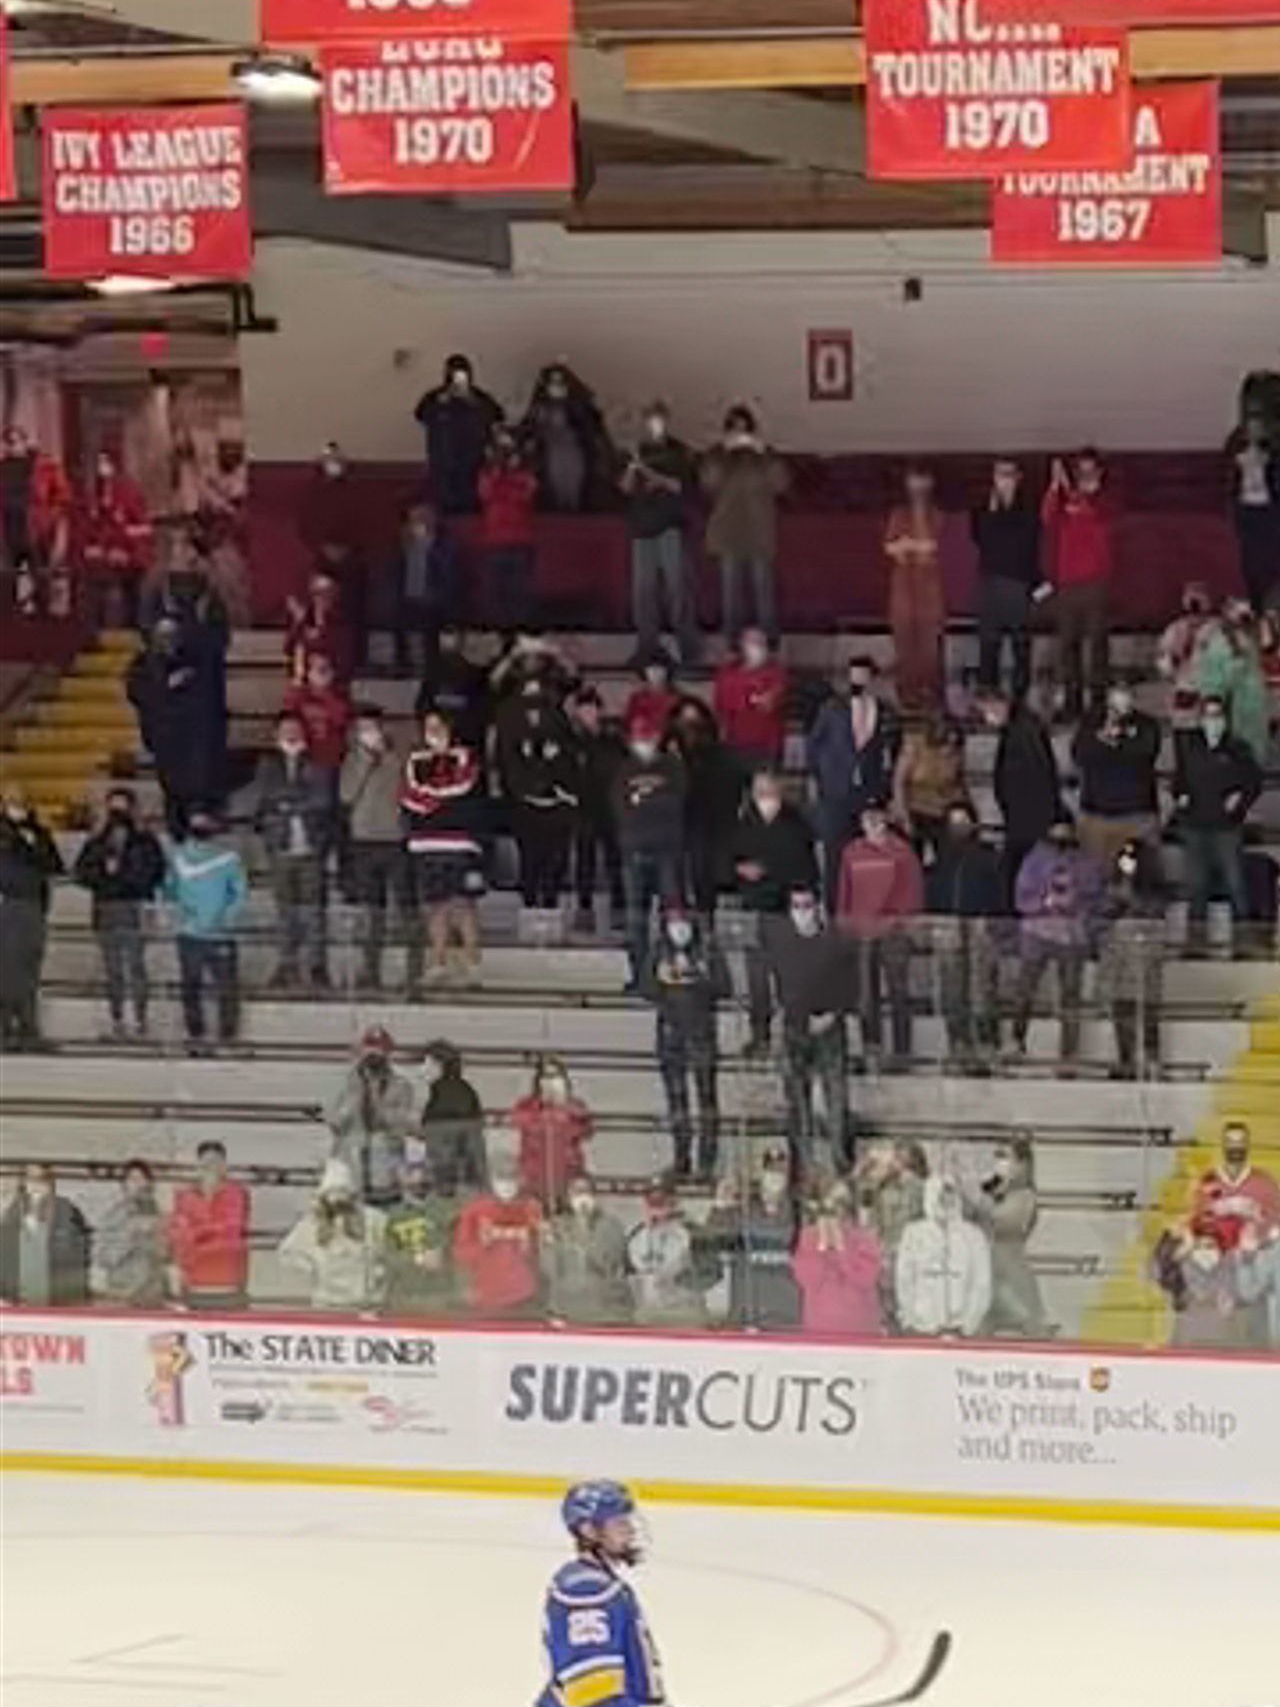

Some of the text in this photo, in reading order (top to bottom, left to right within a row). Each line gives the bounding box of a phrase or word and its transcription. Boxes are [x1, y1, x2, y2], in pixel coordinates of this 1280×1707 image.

[331, 62, 557, 115] CHAMPIONS
[872, 46, 1121, 98] TOURNAMENT
[52, 125, 242, 170] IVY LEAGUE
[392, 116, 494, 166] 1970
[944, 101, 1049, 149] 1970
[54, 167, 242, 213] CHAMPIONS
[1057, 199, 1150, 243] 1967
[205, 1332, 437, 1366] The STATE DINER
[504, 1363, 858, 1436] SUPERCUTS
[957, 1395, 1238, 1440] We print, pack, ship
[957, 1433, 1011, 1462] and
